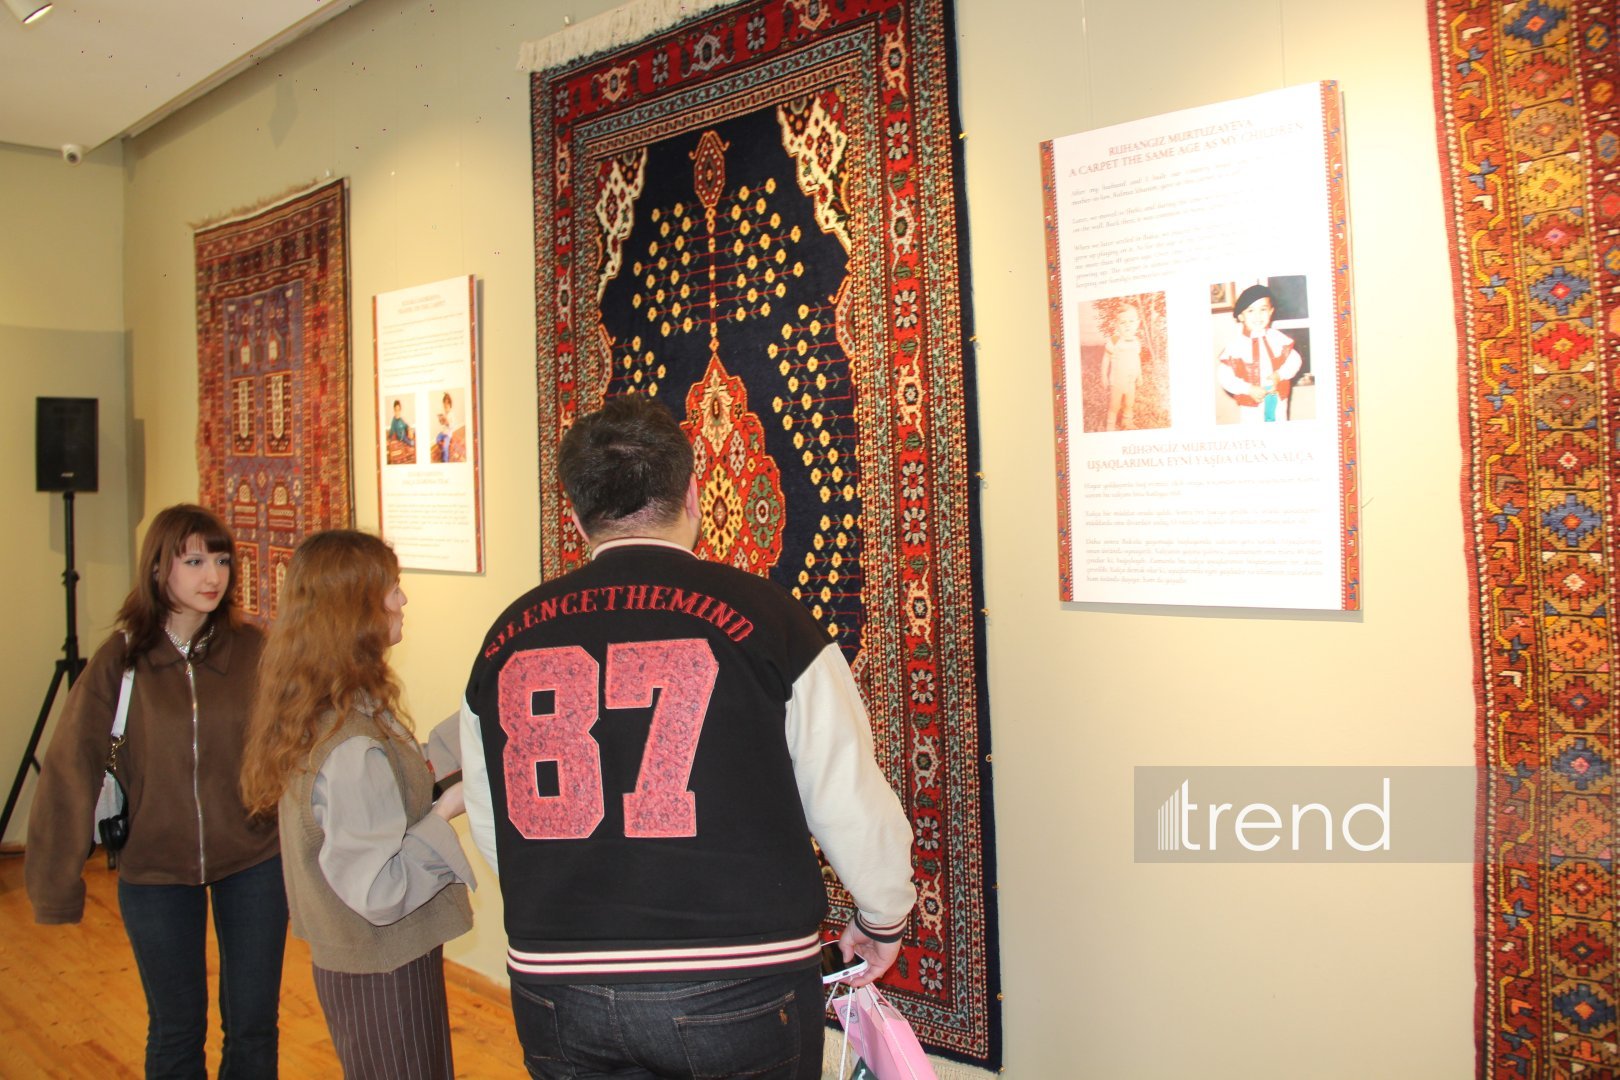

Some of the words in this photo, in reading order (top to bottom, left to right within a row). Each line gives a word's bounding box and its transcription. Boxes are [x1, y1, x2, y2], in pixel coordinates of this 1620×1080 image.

[1068, 167, 1078, 178] A
[1078, 157, 1119, 176] CARPET
[1121, 153, 1144, 169] THE
[1145, 148, 1176, 163] SAME
[1178, 142, 1201, 157] AGE
[1203, 139, 1220, 151] AS
[1221, 134, 1238, 148] MY
[1240, 121, 1304, 144] CHILDREN
[1235, 452, 1269, 464] OLAN
[484, 584, 754, 661] SILENCETHEMIND
[498, 638, 720, 839] 87
